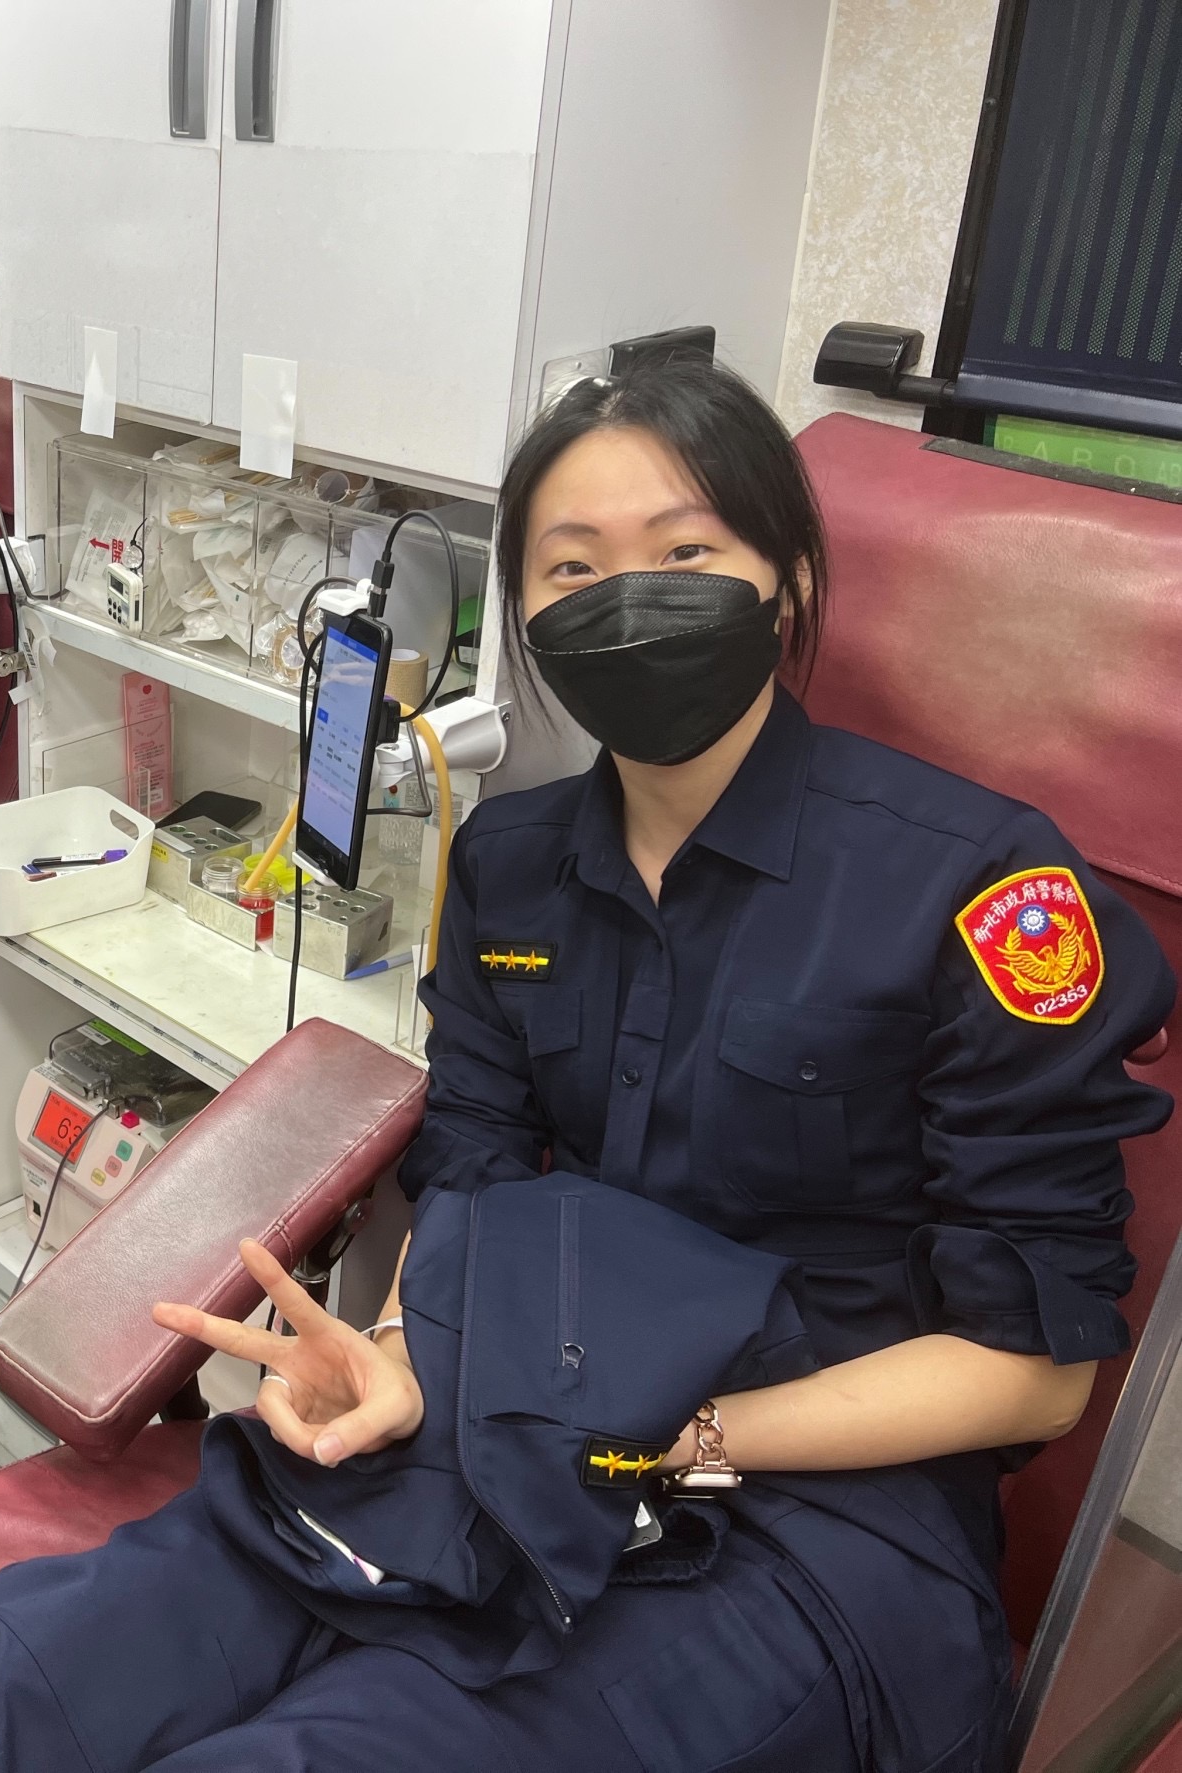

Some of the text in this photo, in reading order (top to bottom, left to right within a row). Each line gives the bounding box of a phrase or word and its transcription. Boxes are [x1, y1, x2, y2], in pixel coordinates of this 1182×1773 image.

[973, 879, 1078, 944] 新北市政府警察局
[1033, 984, 1088, 1016] 02353
